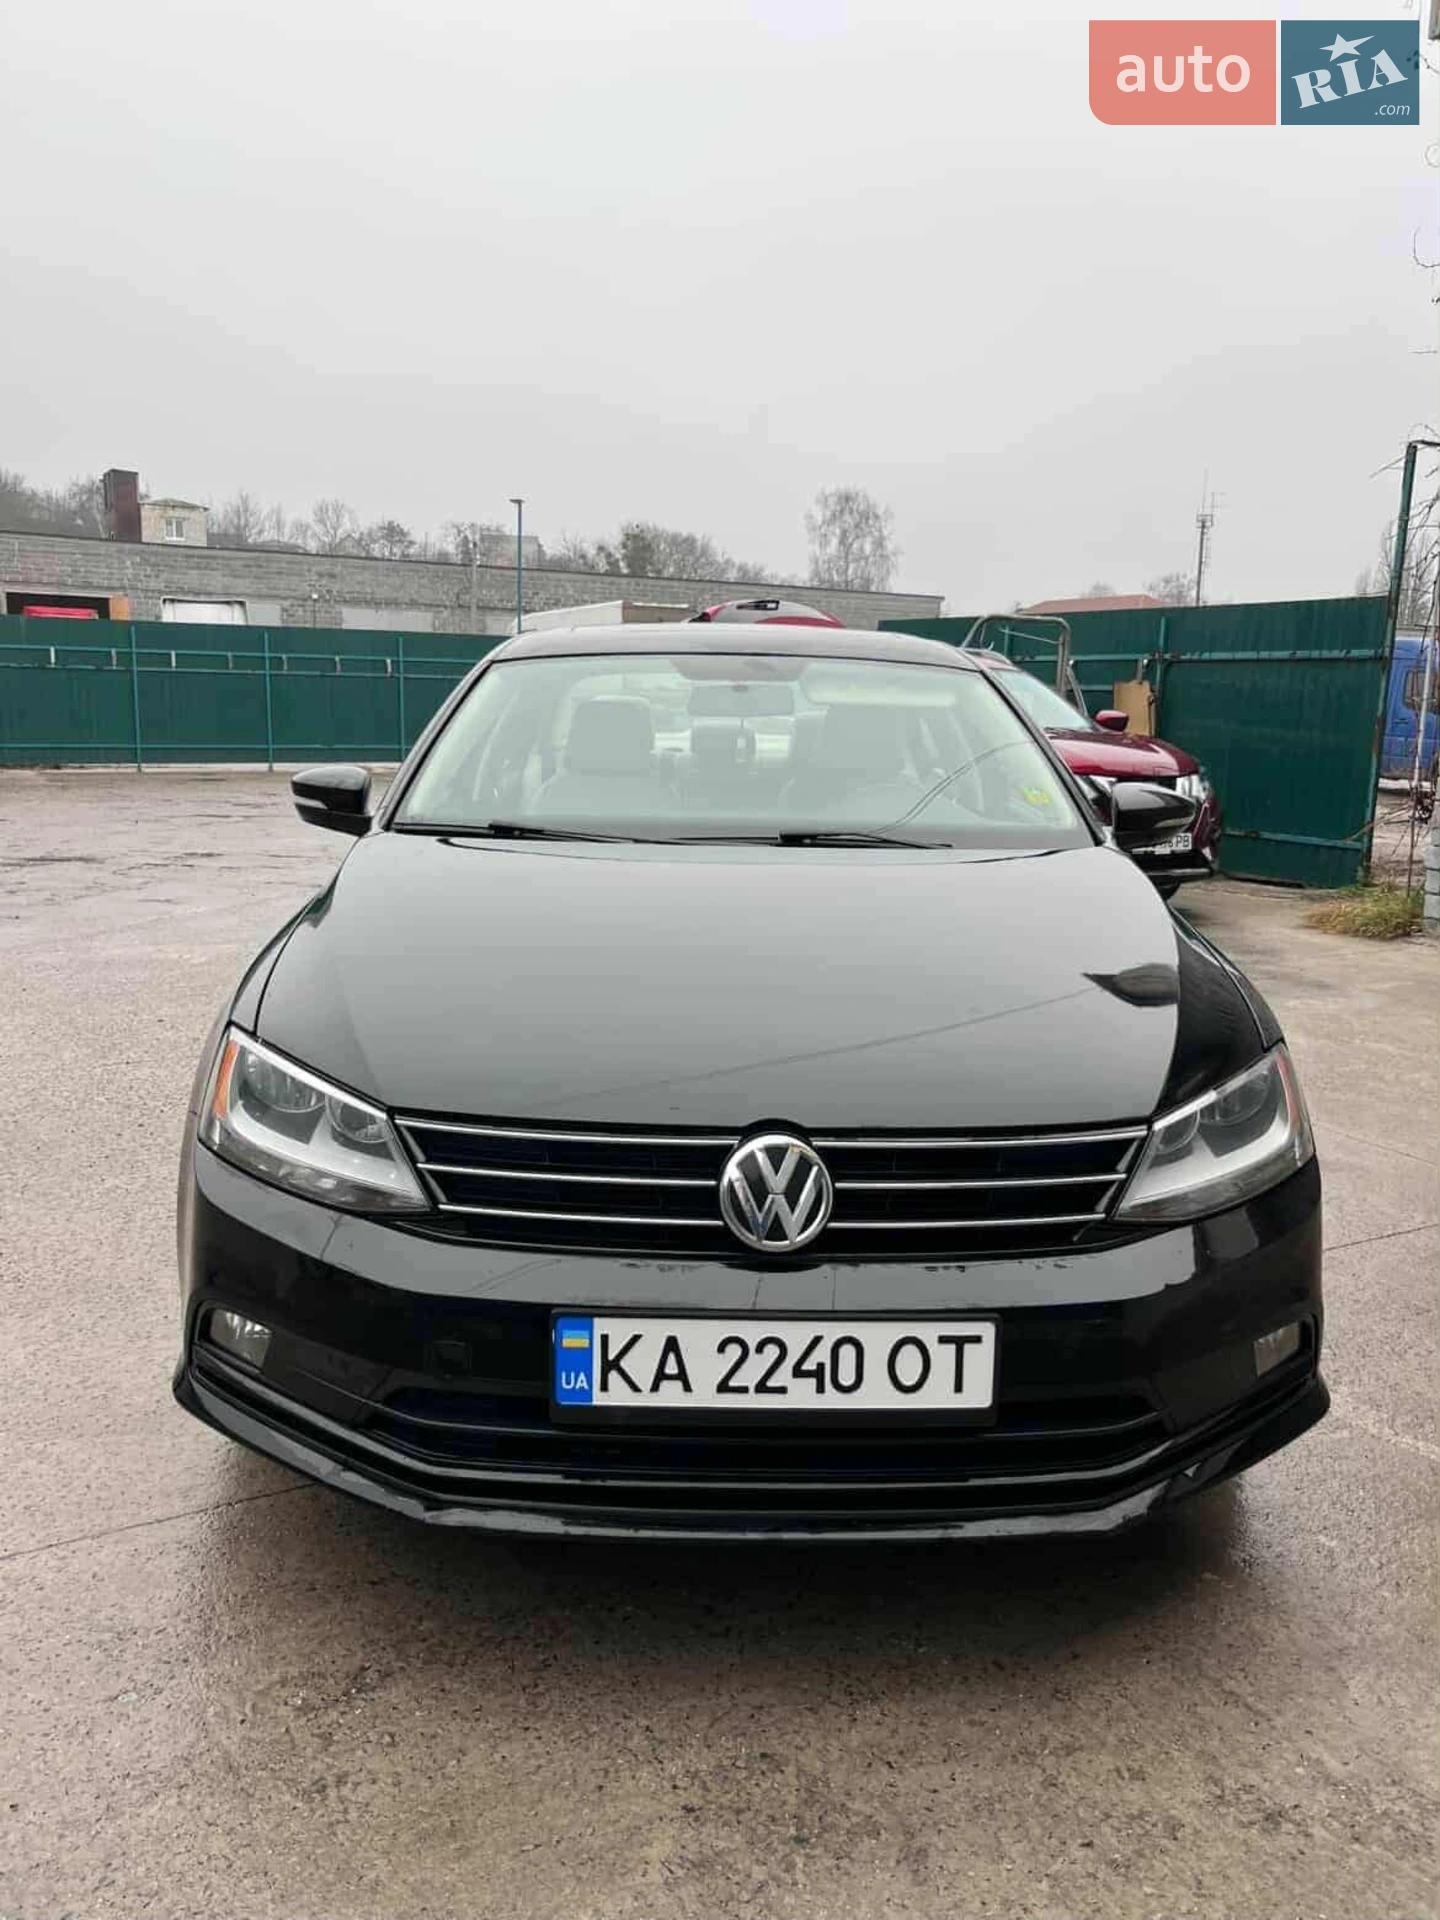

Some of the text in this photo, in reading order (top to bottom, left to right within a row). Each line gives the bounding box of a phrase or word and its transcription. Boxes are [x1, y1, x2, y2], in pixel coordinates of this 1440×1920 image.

[561, 1371, 589, 1390] UA
[600, 1333, 983, 1394] KA 2240 OT
